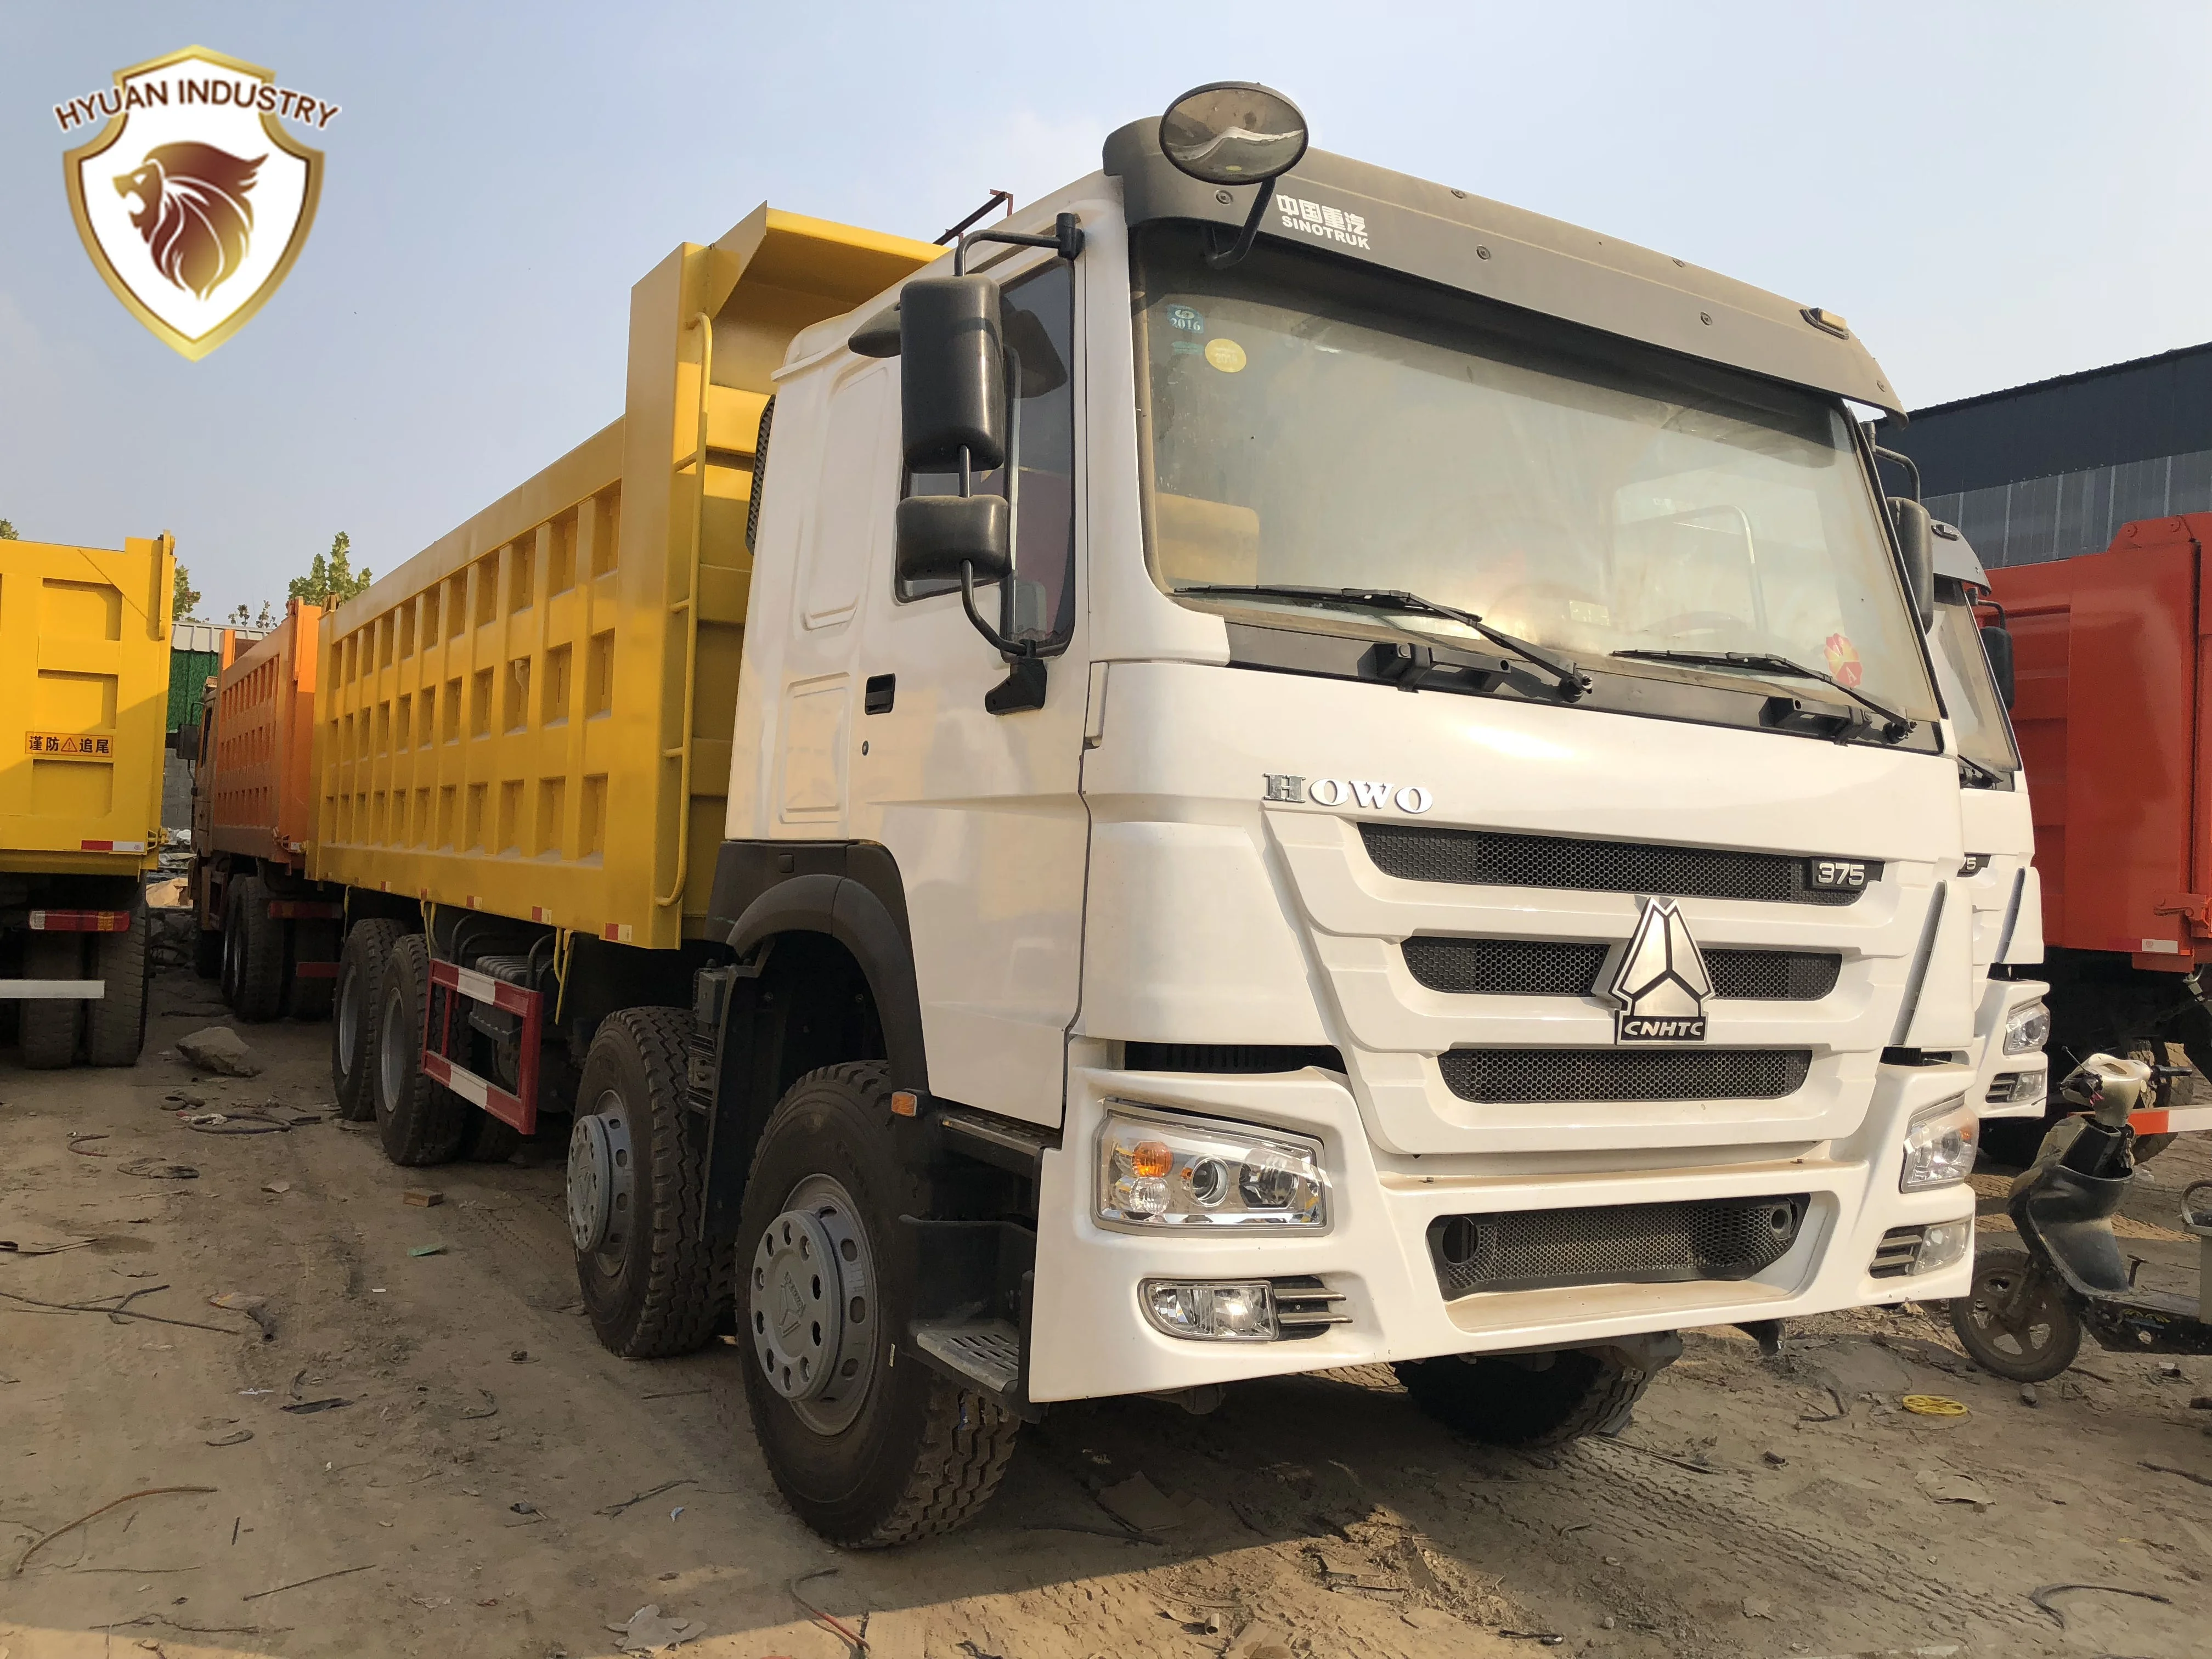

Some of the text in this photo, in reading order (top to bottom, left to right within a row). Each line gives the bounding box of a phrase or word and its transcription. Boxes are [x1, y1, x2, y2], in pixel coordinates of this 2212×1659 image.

[1276, 194, 1368, 236] 中国重汽
[1282, 215, 1370, 250] SINOTRUK
[1171, 318, 1200, 331] 2016
[1262, 772, 1433, 814] HOWO
[1818, 862, 1865, 885] 375
[1624, 1021, 1703, 1036] CNHTC
